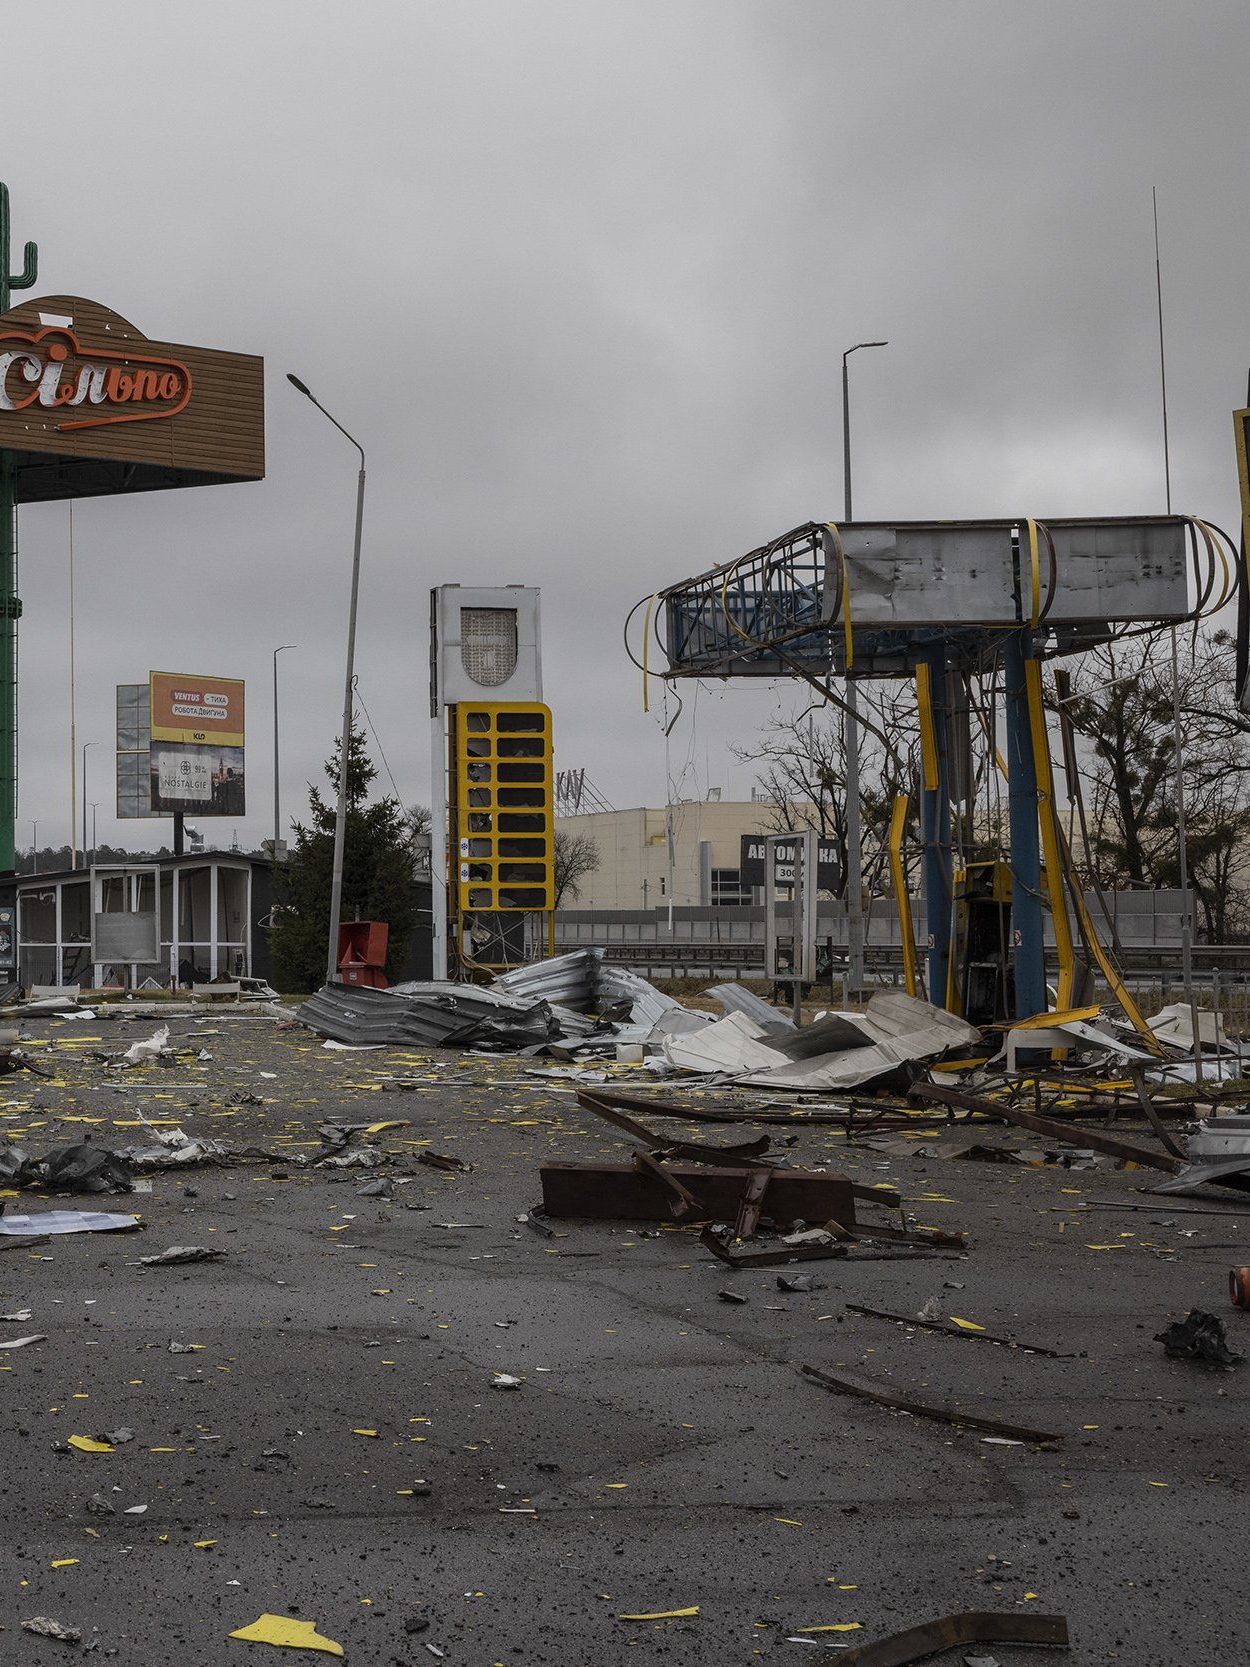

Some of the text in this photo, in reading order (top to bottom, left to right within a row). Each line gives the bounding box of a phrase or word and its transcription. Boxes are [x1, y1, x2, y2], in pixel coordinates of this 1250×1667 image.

[174, 692, 200, 701] VENTUS
[174, 706, 226, 717] РОБОТА ДВИГУНА
[165, 779, 207, 789] NOSTALGIE
